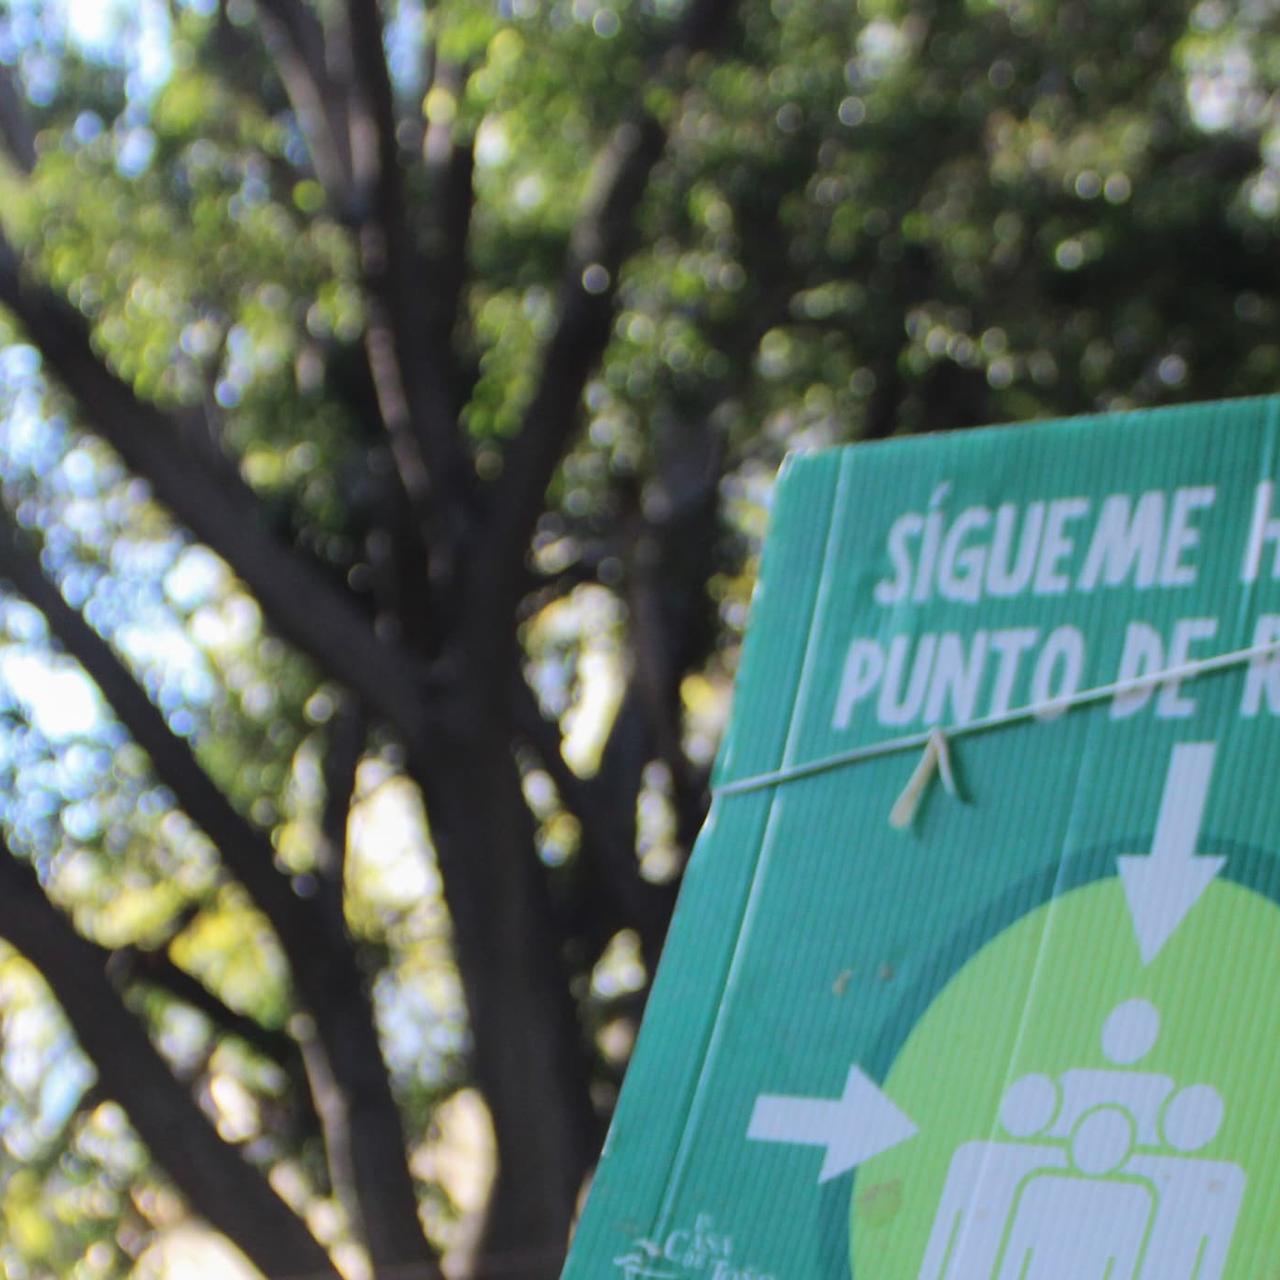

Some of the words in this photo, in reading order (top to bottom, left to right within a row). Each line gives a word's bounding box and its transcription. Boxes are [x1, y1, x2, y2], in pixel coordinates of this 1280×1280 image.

[874, 481, 1217, 606] SÍGUEME
[831, 625, 1085, 731] PUNTO
[1109, 617, 1218, 720] DE
